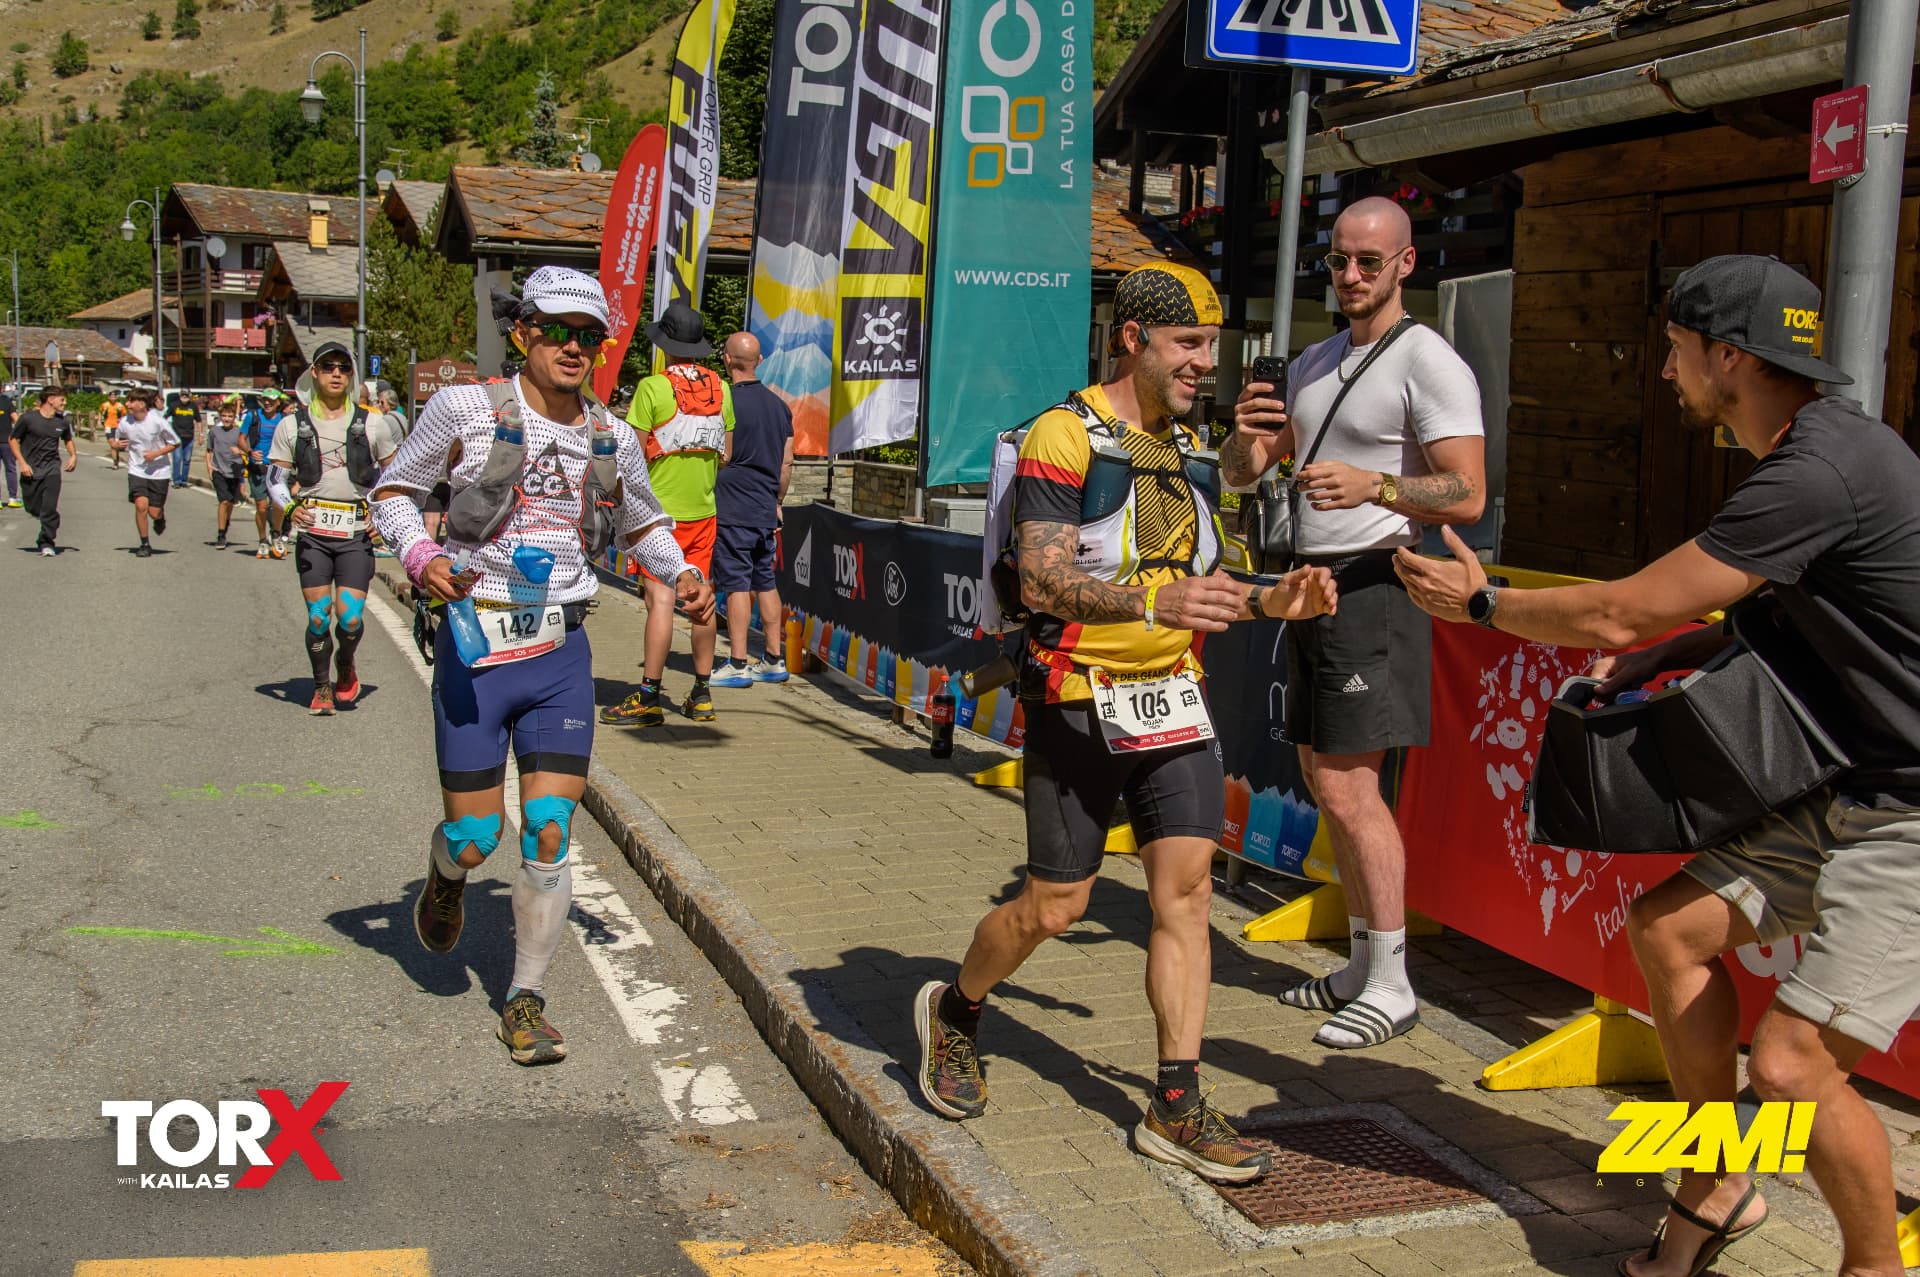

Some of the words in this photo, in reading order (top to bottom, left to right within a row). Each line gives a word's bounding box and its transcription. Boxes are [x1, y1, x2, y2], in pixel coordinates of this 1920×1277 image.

[787, 0, 854, 116] TO
[1061, 26, 1076, 93] CASA
[702, 77, 717, 151] POWER
[1061, 101, 1075, 151] TUA
[842, 0, 941, 274] UGA
[665, 58, 704, 305] FUGA
[698, 157, 713, 205] GRIP
[1061, 158, 1074, 189] LA
[954, 269, 1071, 288] WWW.CDS.IT
[844, 358, 917, 374] KAILAS
[321, 512, 343, 526] 317
[833, 542, 866, 600] TORX
[944, 573, 984, 626] TO
[496, 612, 537, 639] 142
[514, 649, 527, 657] SOS
[1119, 673, 1138, 682] DES
[1342, 685, 1369, 693] adidas
[1129, 689, 1171, 721] 105
[1142, 718, 1164, 727] BOJAN
[1152, 734, 1166, 743] SOS
